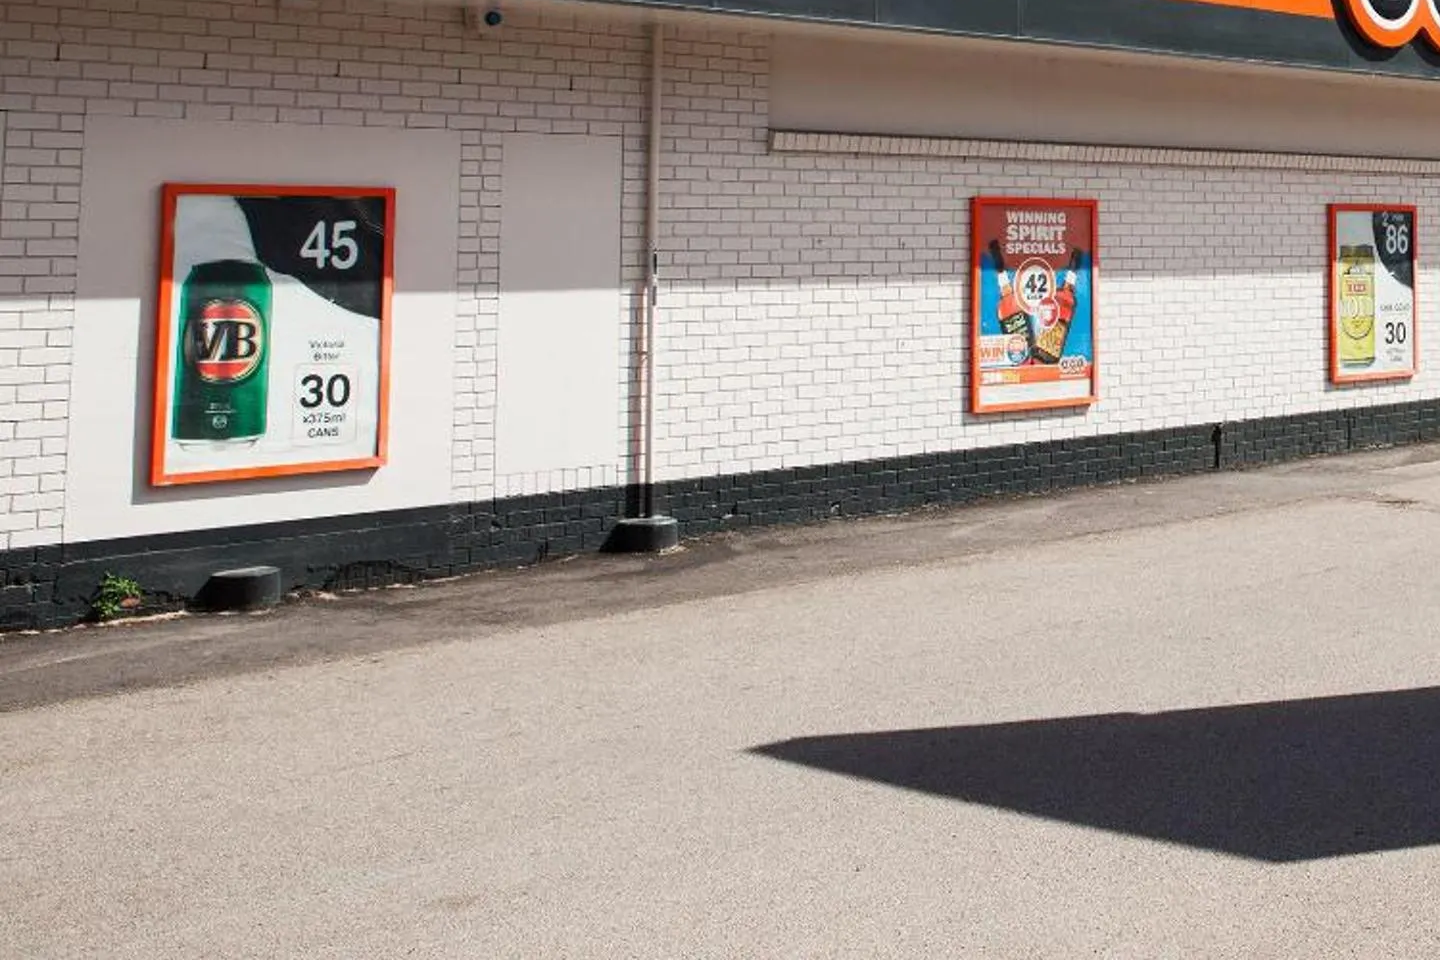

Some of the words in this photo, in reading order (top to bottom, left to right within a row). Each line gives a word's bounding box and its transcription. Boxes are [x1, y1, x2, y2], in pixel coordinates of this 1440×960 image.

[1006, 211, 1066, 224] WINNING
[1006, 224, 1067, 241] SPIRIT
[1386, 224, 1409, 254] 86
[299, 220, 359, 270] 45
[1006, 241, 1066, 254] SPECIALS
[1025, 273, 1048, 293] 42
[196, 320, 257, 361] VB
[1385, 322, 1407, 345] 30
[300, 373, 351, 408] 30
[307, 426, 340, 438] CANS
